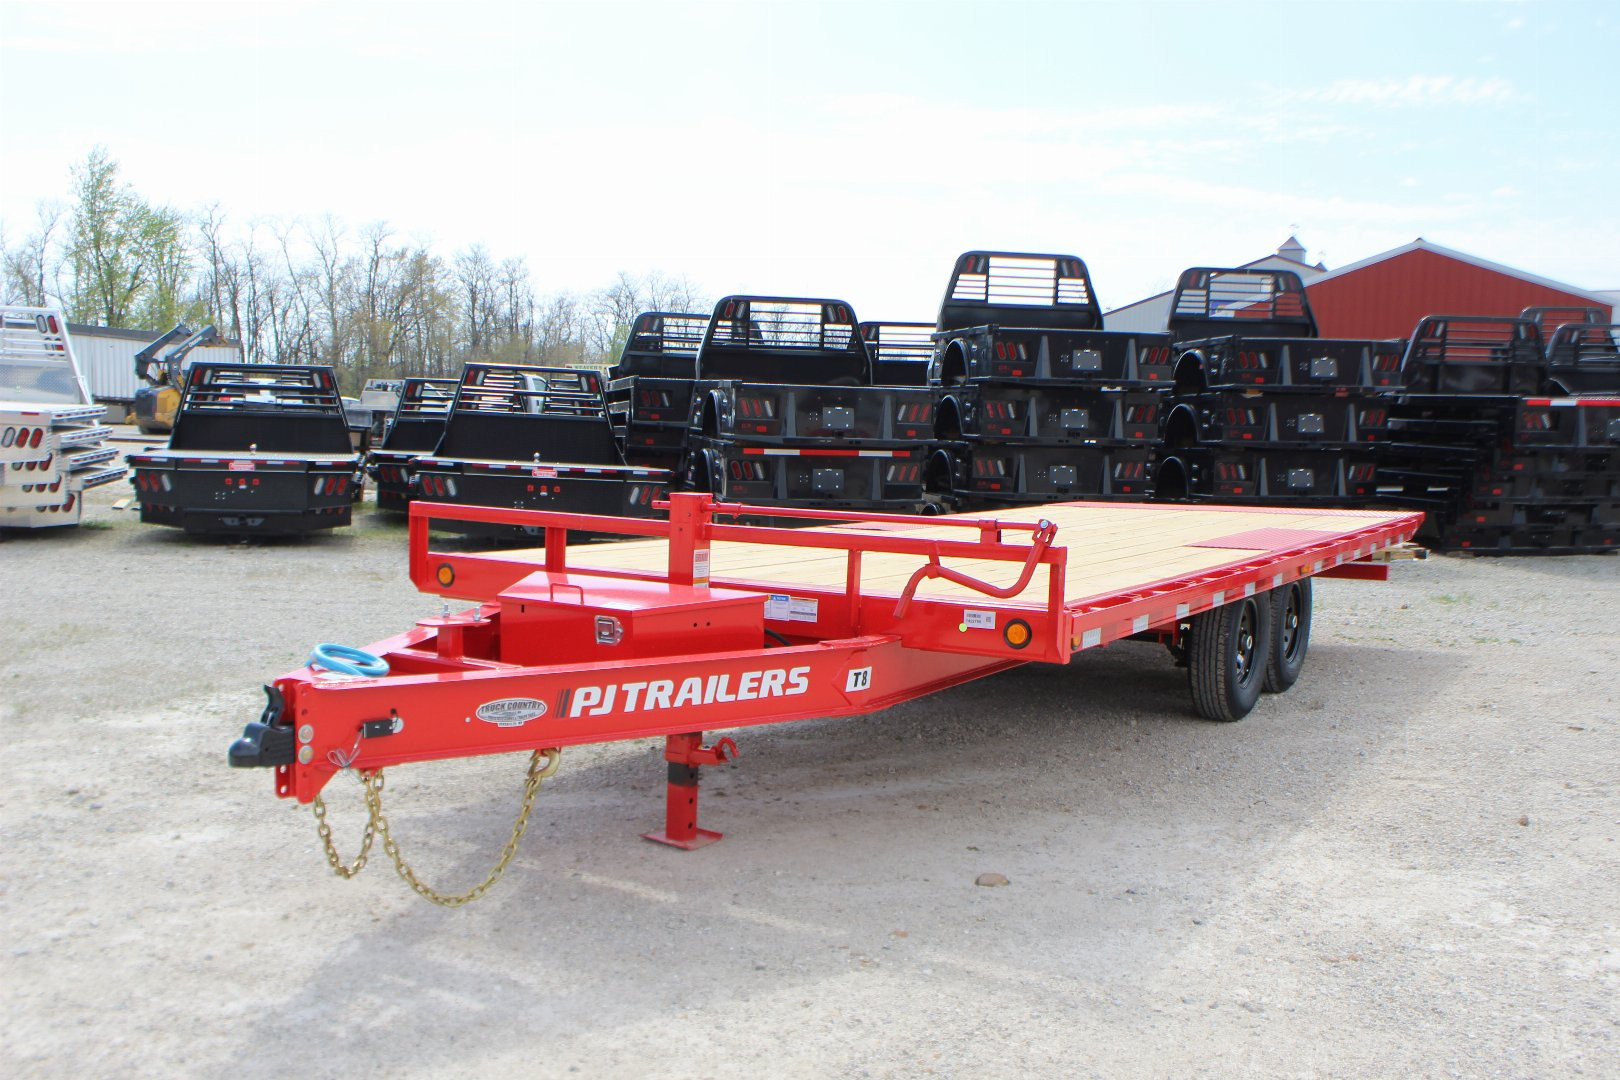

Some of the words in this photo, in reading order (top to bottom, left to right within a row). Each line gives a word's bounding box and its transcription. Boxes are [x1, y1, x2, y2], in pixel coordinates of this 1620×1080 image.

[853, 670, 868, 688] T8
[569, 684, 618, 718] PJ
[621, 665, 811, 713] TRAILERS
[480, 703, 507, 713] TRUCK
[507, 701, 541, 710] COUNTRY
